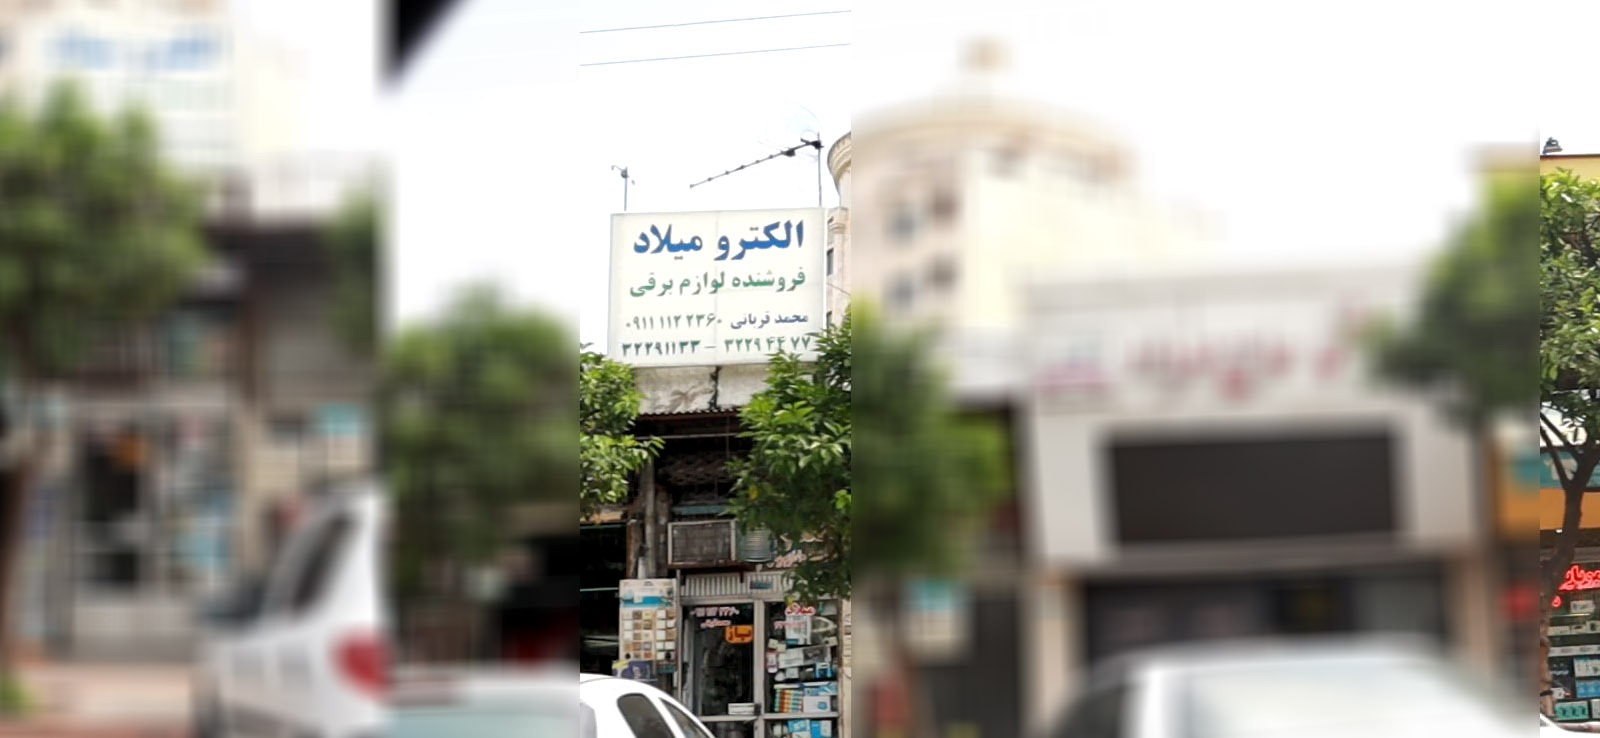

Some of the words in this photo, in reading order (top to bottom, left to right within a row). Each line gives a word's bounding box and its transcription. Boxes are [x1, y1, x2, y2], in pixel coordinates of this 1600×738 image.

[633, 224, 703, 260] میلاد
[714, 220, 804, 261] الکترو
[630, 272, 673, 297] برقی
[679, 271, 725, 295] لوازم
[731, 267, 806, 292] فروشنده
[730, 311, 770, 330] قربانی
[774, 313, 809, 324] محمد
